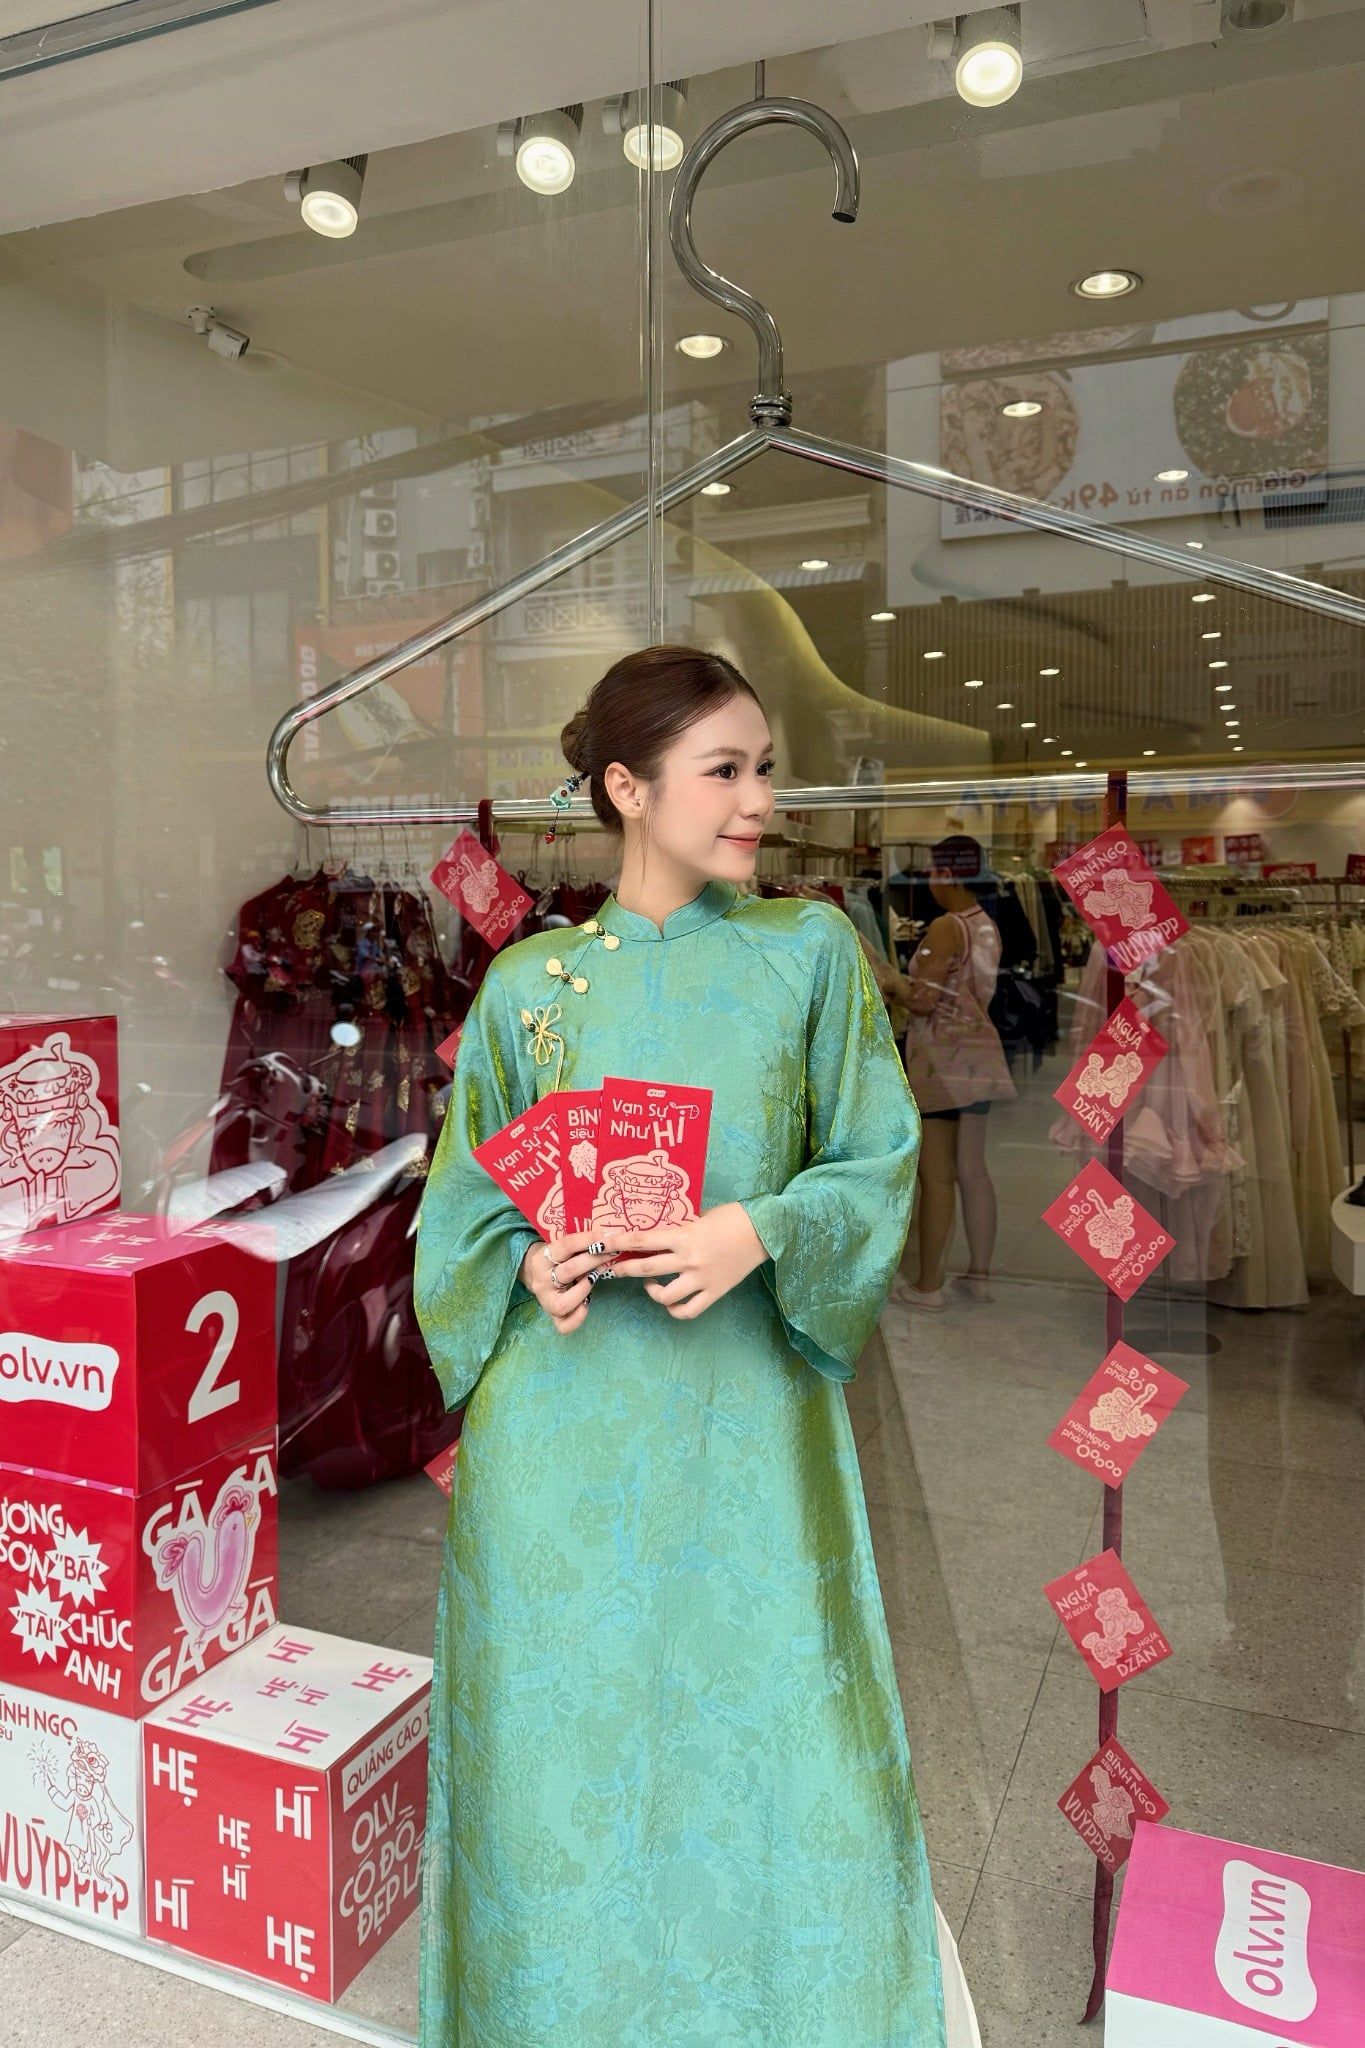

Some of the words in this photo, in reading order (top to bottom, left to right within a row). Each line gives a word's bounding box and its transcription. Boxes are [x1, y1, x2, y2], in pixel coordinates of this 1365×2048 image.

[568, 1105, 602, 1127] BÍN
[610, 1120, 651, 1140] Như
[612, 1098, 643, 1116] Vạn
[649, 1102, 670, 1120] Sự
[493, 1151, 524, 1173] Vạn
[522, 1127, 542, 1152] Sự
[569, 1127, 595, 1140] siêu
[508, 1159, 545, 1192] Như
[0, 1346, 105, 1394] olv.vn
[184, 1290, 241, 1424] 2
[1055, 1581, 1100, 1614] NGỰA
[67, 1608, 134, 1653] CHÚC
[64, 1650, 122, 1700] ANH
[256, 1676, 300, 1698] HẸ
[351, 1662, 414, 1694] HẸ
[34, 1708, 78, 1746] NGỌ
[166, 1694, 234, 1728] HẸ
[152, 1742, 199, 1808] HẸ
[346, 1744, 394, 1796] QUẢNG
[396, 1715, 423, 1756] CÁO
[275, 1786, 320, 1841] HÍ
[350, 1781, 402, 1854] OLV
[1129, 1782, 1157, 1815] NGỌ
[218, 1814, 251, 1859] HẸ
[222, 1864, 252, 1902] HÍ
[338, 1854, 376, 1918] CÓ
[380, 1804, 417, 1883] ĐỒ
[154, 1878, 195, 1931] HÍ
[357, 1873, 402, 1948] ĐẸP
[266, 1915, 316, 1984] HẸ
[1233, 1879, 1286, 1997] olv.vn
